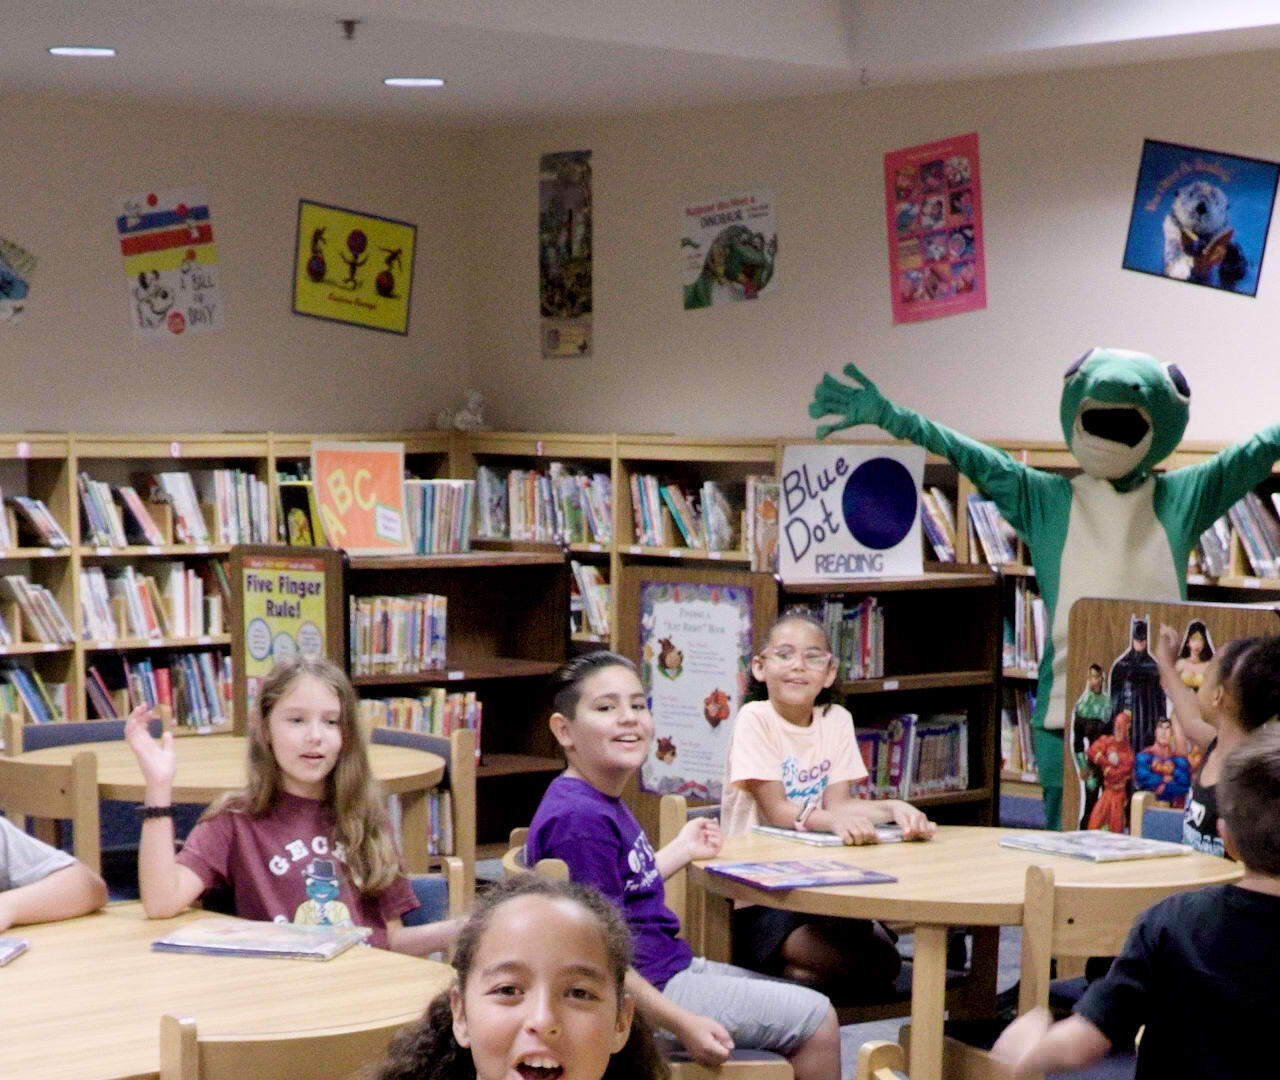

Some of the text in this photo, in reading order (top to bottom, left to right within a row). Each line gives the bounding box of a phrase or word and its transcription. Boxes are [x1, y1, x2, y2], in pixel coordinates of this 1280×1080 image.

[783, 457, 849, 515] Blue
[320, 467, 377, 549] ABC
[785, 499, 840, 562] Dot
[815, 553, 884, 574] READING
[247, 574, 321, 598] Five Finger
[266, 599, 300, 618] Rule!
[268, 835, 347, 876] GECK
